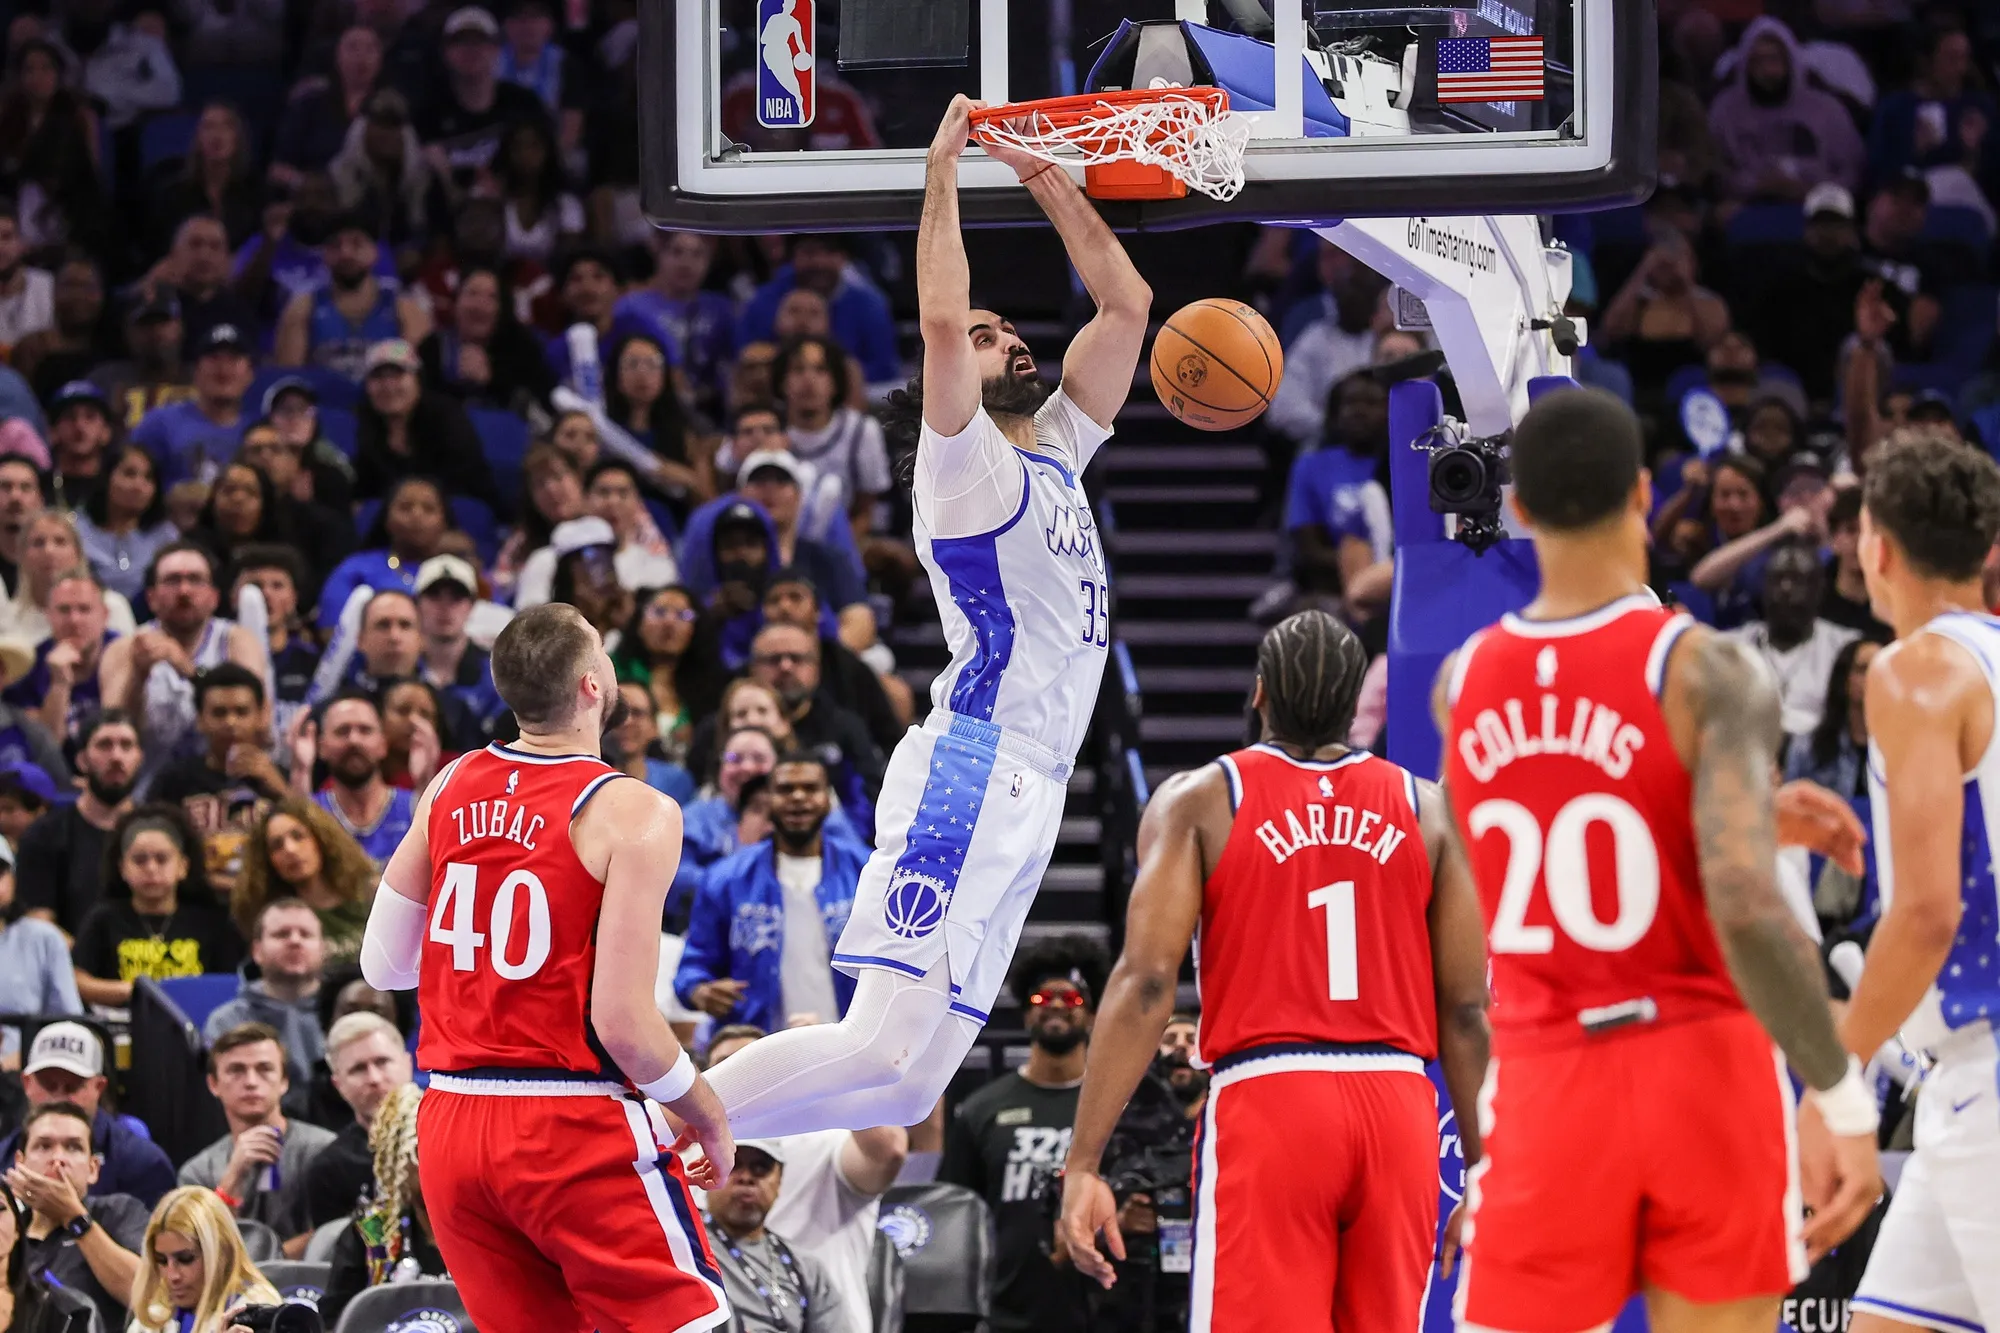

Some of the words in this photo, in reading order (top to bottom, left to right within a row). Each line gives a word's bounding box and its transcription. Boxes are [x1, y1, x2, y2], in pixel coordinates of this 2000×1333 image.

[765, 97, 793, 119] NBA
[1407, 217, 1496, 278] GoTimesharing.com
[1078, 577, 1108, 651] 35
[1457, 693, 1646, 784] COLLINS
[451, 799, 546, 851] ZUBAC
[1255, 803, 1407, 866] HARDEN
[1467, 791, 1662, 955] 20
[429, 861, 552, 981] 40
[1307, 880, 1359, 1001] 1
